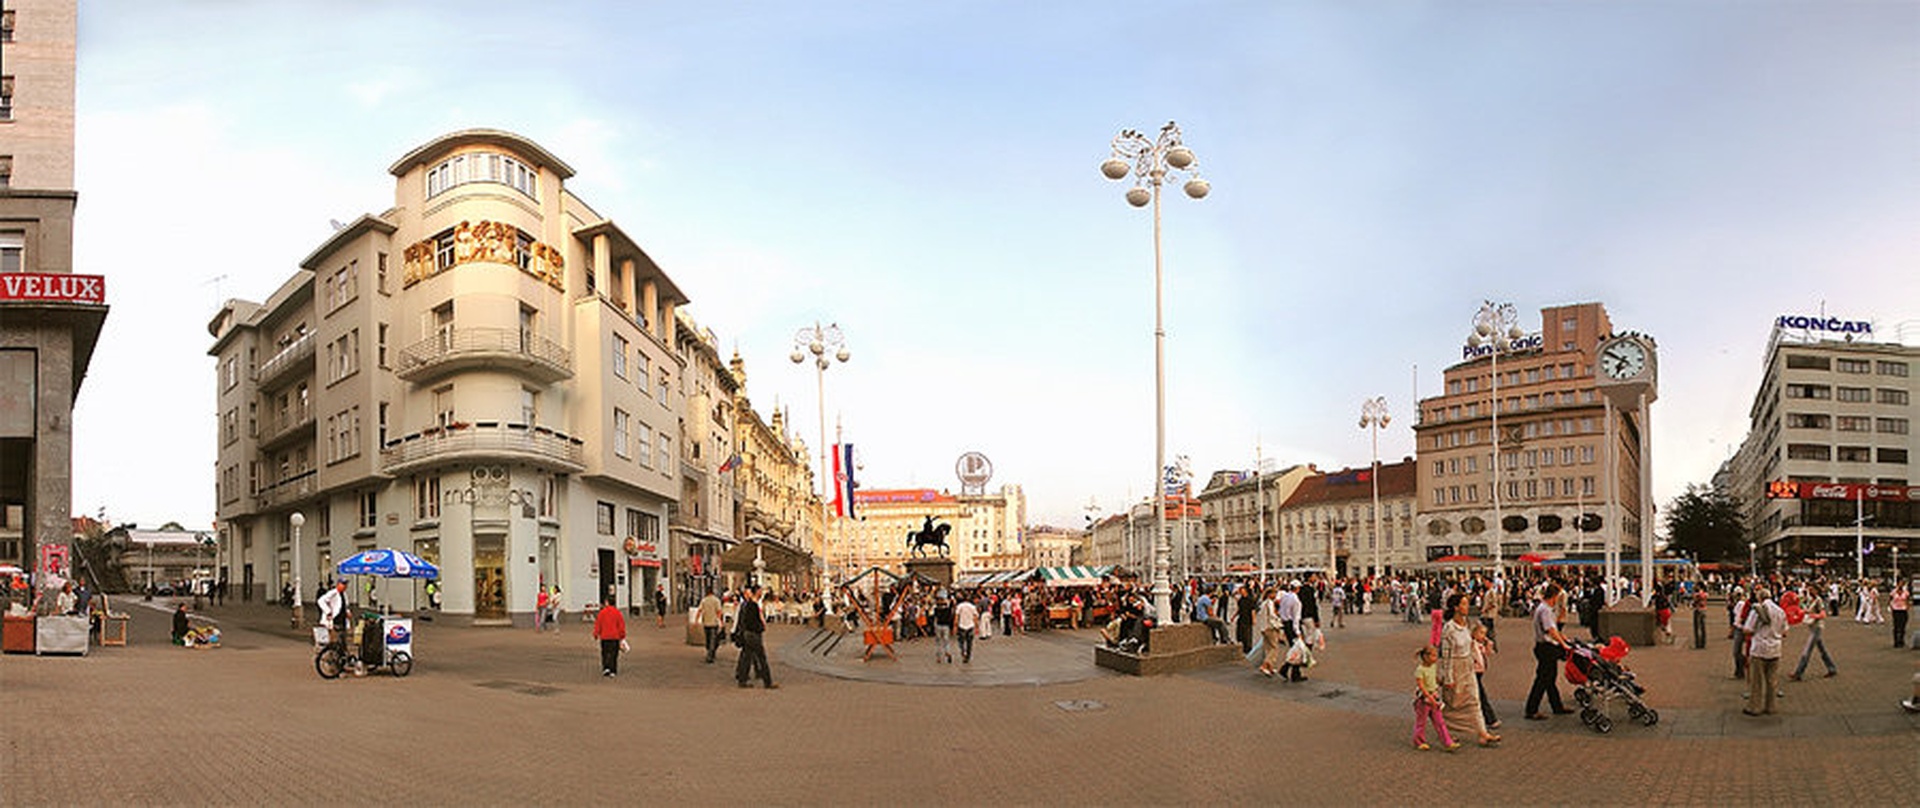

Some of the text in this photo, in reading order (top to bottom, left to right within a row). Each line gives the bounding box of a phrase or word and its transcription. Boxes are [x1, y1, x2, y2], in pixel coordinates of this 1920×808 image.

[3, 276, 99, 298] VELUX
[1779, 315, 1872, 333] KONČAR
[1463, 335, 1543, 359] Panonic
